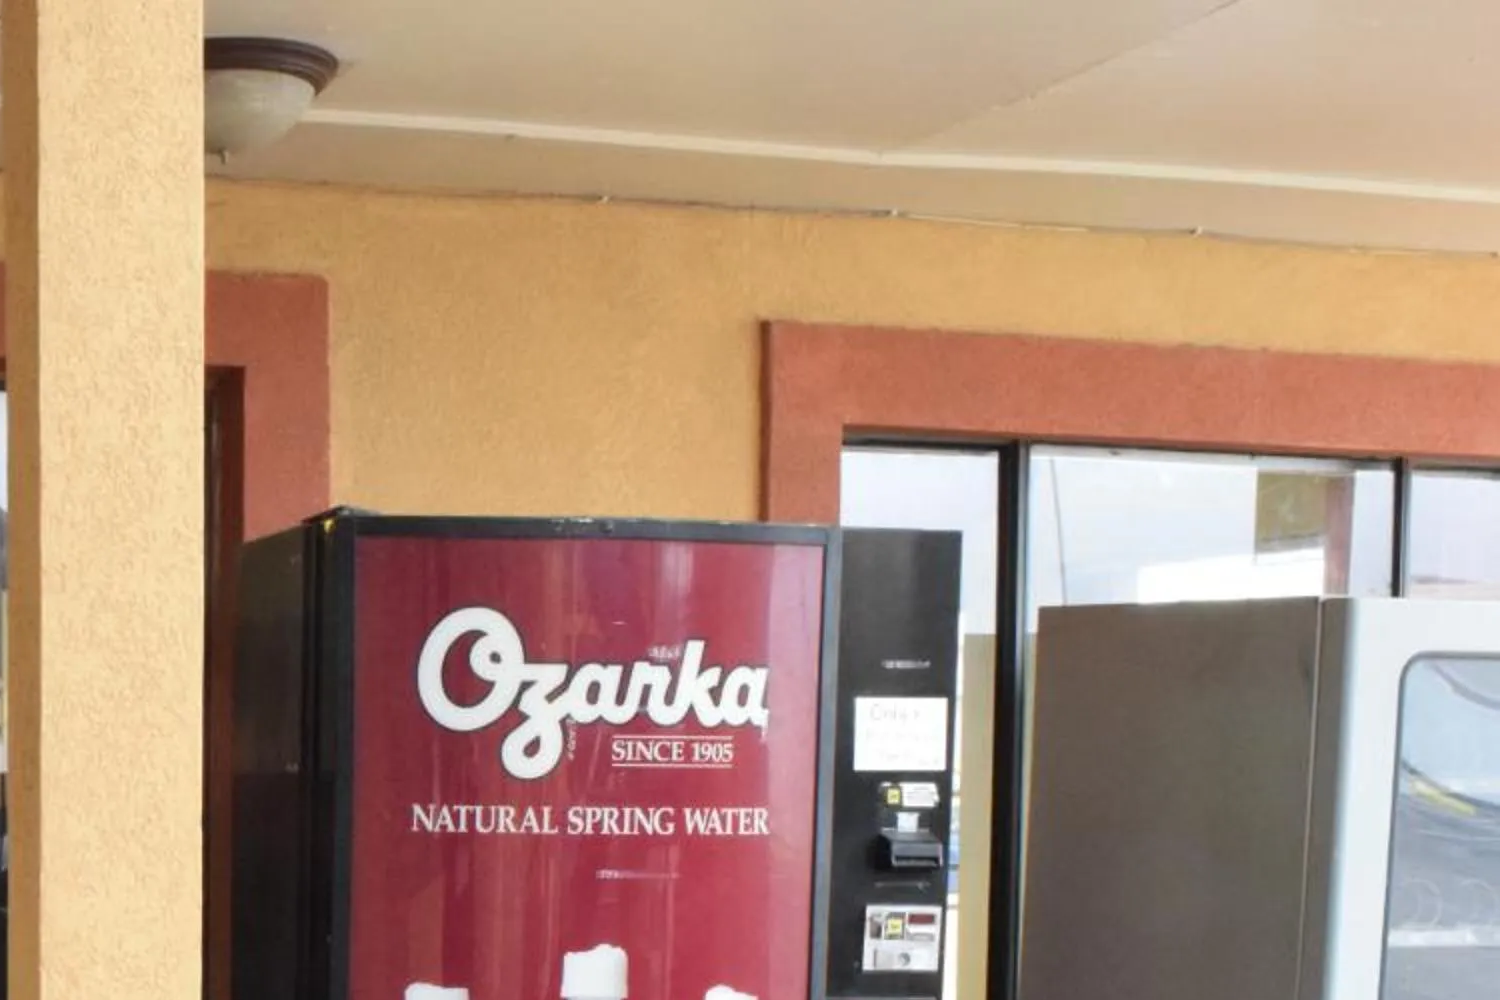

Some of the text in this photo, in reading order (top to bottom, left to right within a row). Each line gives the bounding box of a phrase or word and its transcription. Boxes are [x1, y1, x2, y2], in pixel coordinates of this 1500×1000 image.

[417, 606, 769, 779] Ozarka
[611, 739, 733, 763] SINCE 1905
[411, 803, 770, 836] NATURAL SPRING WATER
